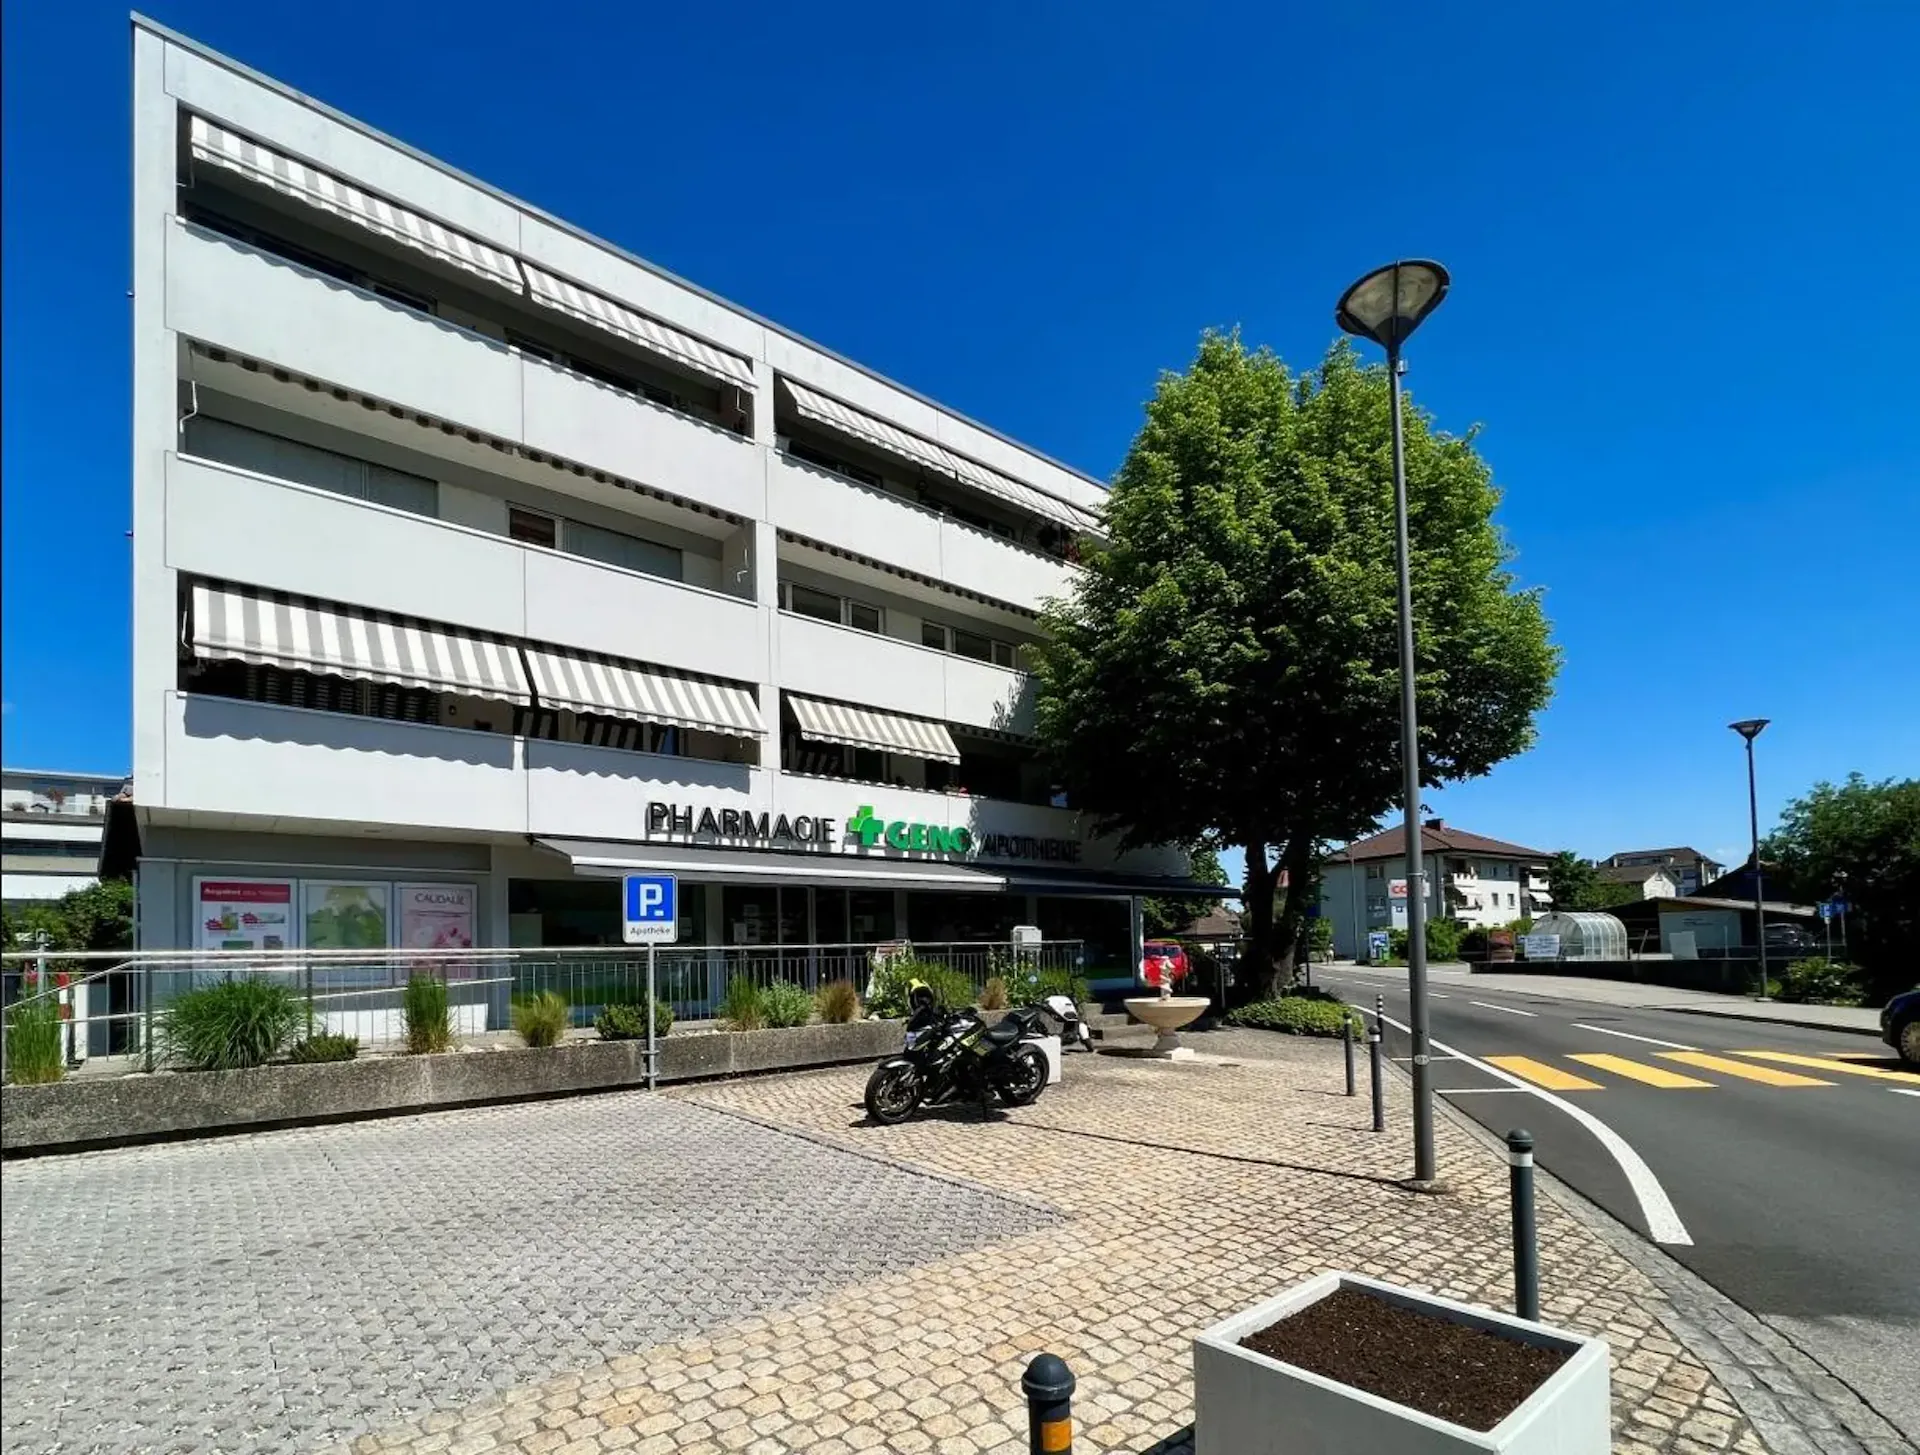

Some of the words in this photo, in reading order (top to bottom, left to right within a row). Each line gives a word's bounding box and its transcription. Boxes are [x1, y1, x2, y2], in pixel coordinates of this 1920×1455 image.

[645, 801, 836, 843] PHARMACIE
[885, 821, 972, 853] GENO
[630, 927, 670, 936] Apotheke
